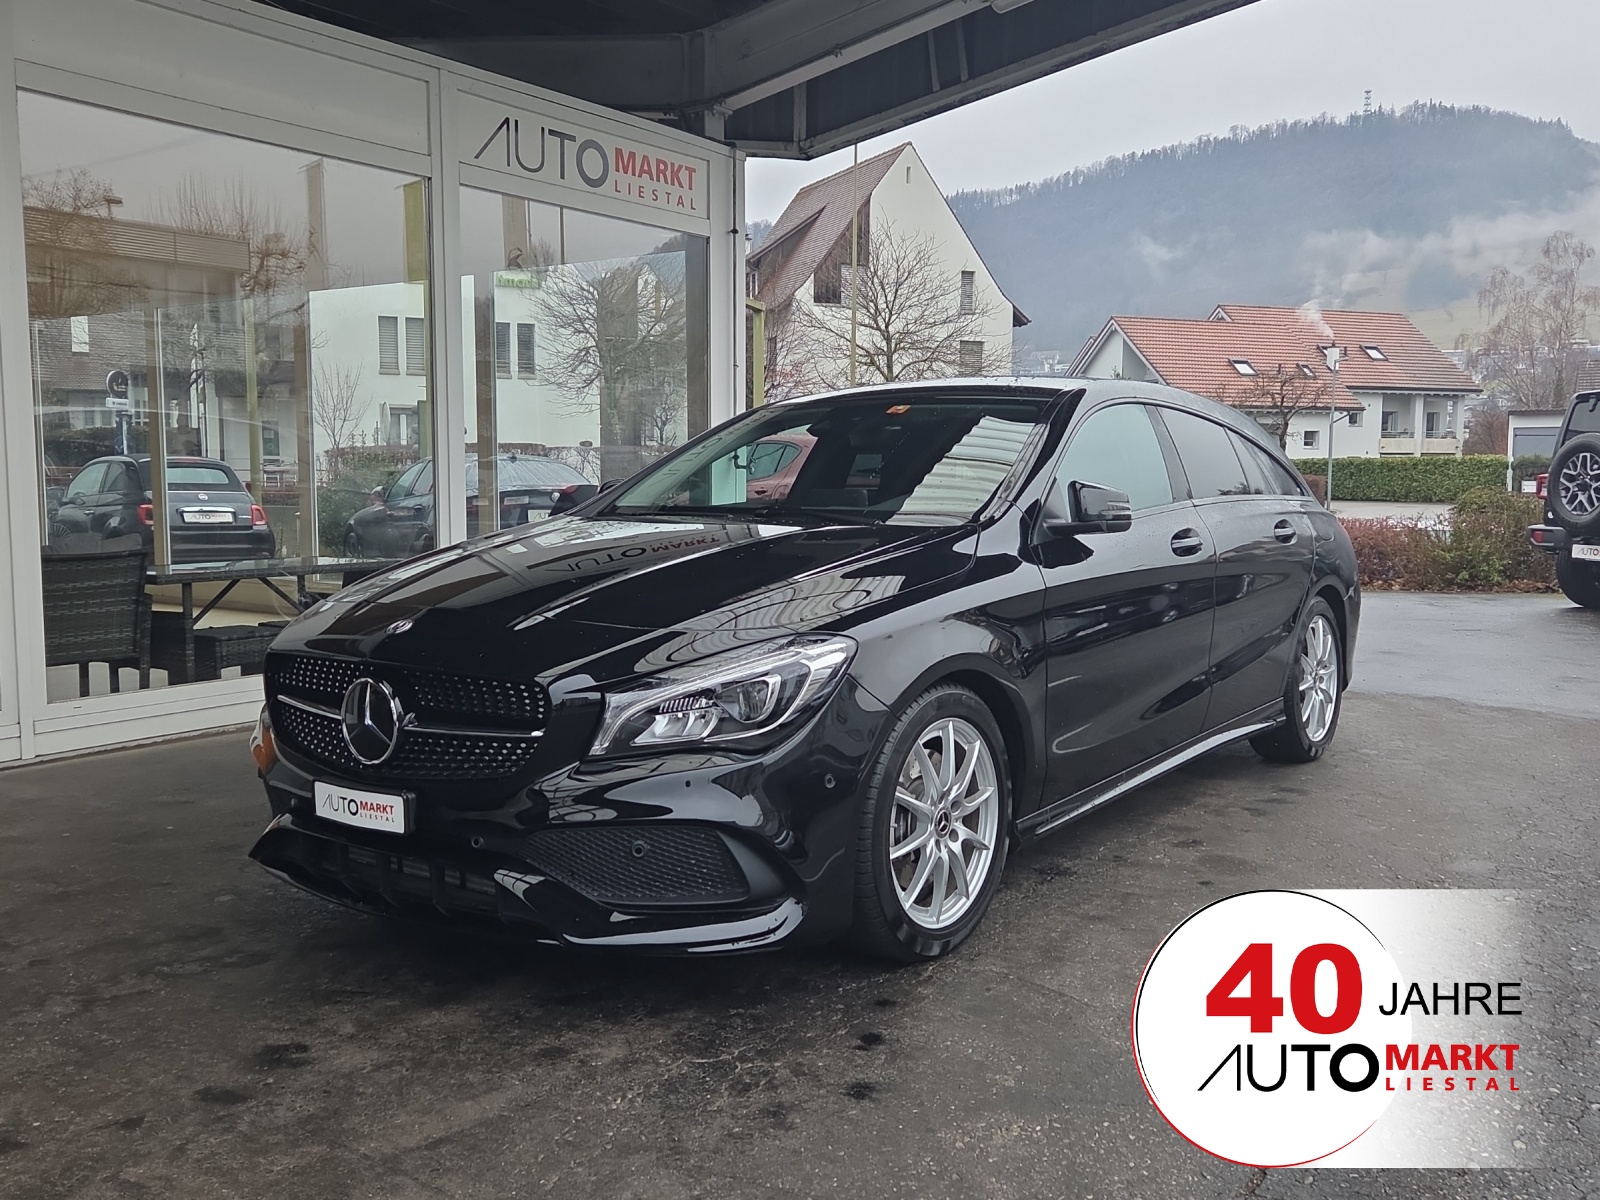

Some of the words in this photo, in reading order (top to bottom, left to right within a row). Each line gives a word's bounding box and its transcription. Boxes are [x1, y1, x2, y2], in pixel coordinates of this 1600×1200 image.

[474, 116, 609, 188] AUTO
[614, 147, 696, 191] MARKT
[614, 179, 696, 211] LIESTAL
[1577, 547, 1599, 556] AUTO
[322, 793, 359, 816] AUTO
[360, 800, 395, 815] MARKT
[360, 813, 395, 823] LIESTAL
